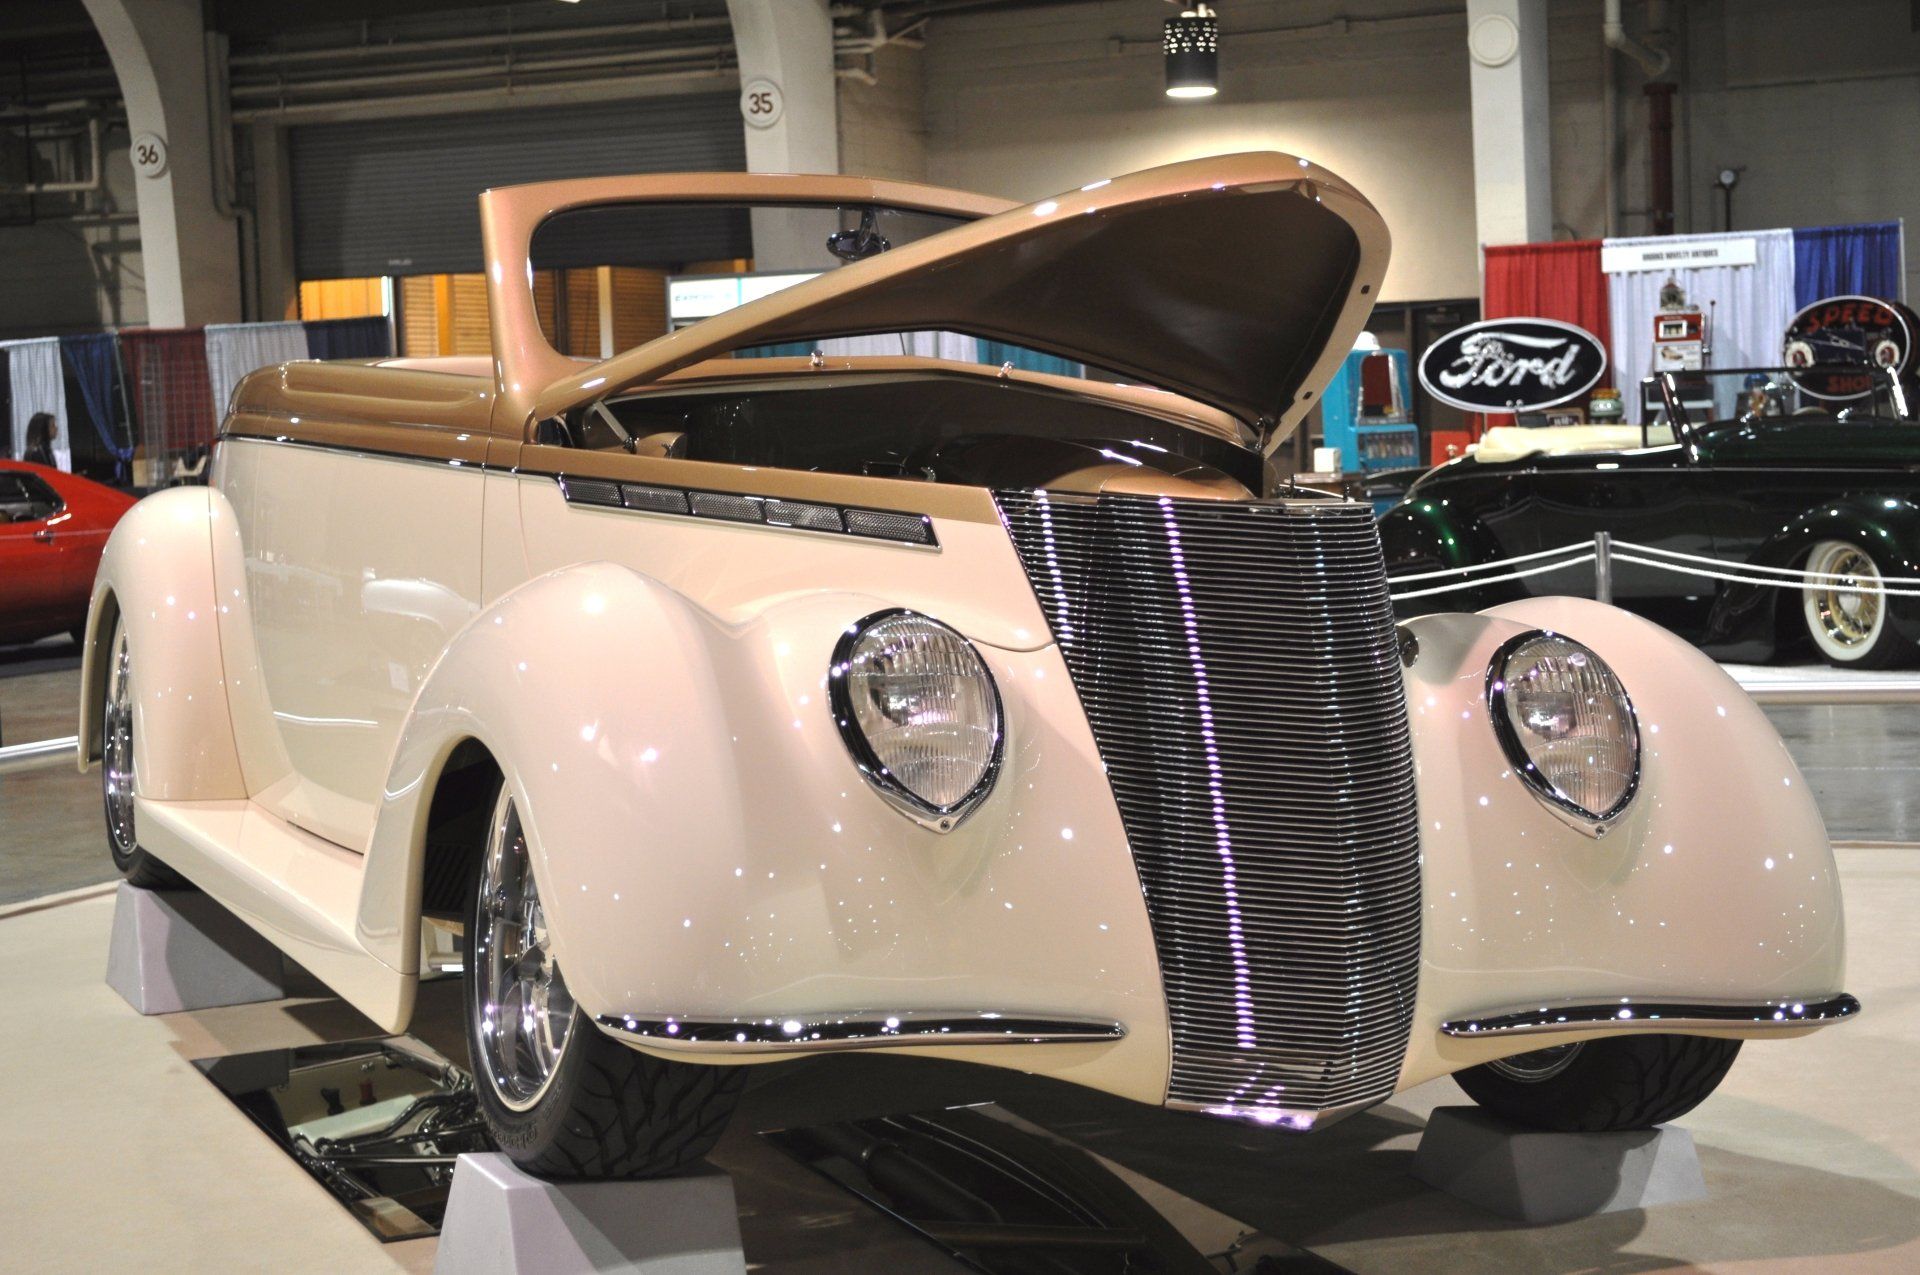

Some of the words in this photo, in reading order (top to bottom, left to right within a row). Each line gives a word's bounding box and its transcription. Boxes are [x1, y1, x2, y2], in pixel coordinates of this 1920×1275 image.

[749, 92, 773, 114] 35
[137, 144, 159, 165] 36
[1807, 303, 1893, 334] SPEED
[1439, 332, 1581, 389] Ford
